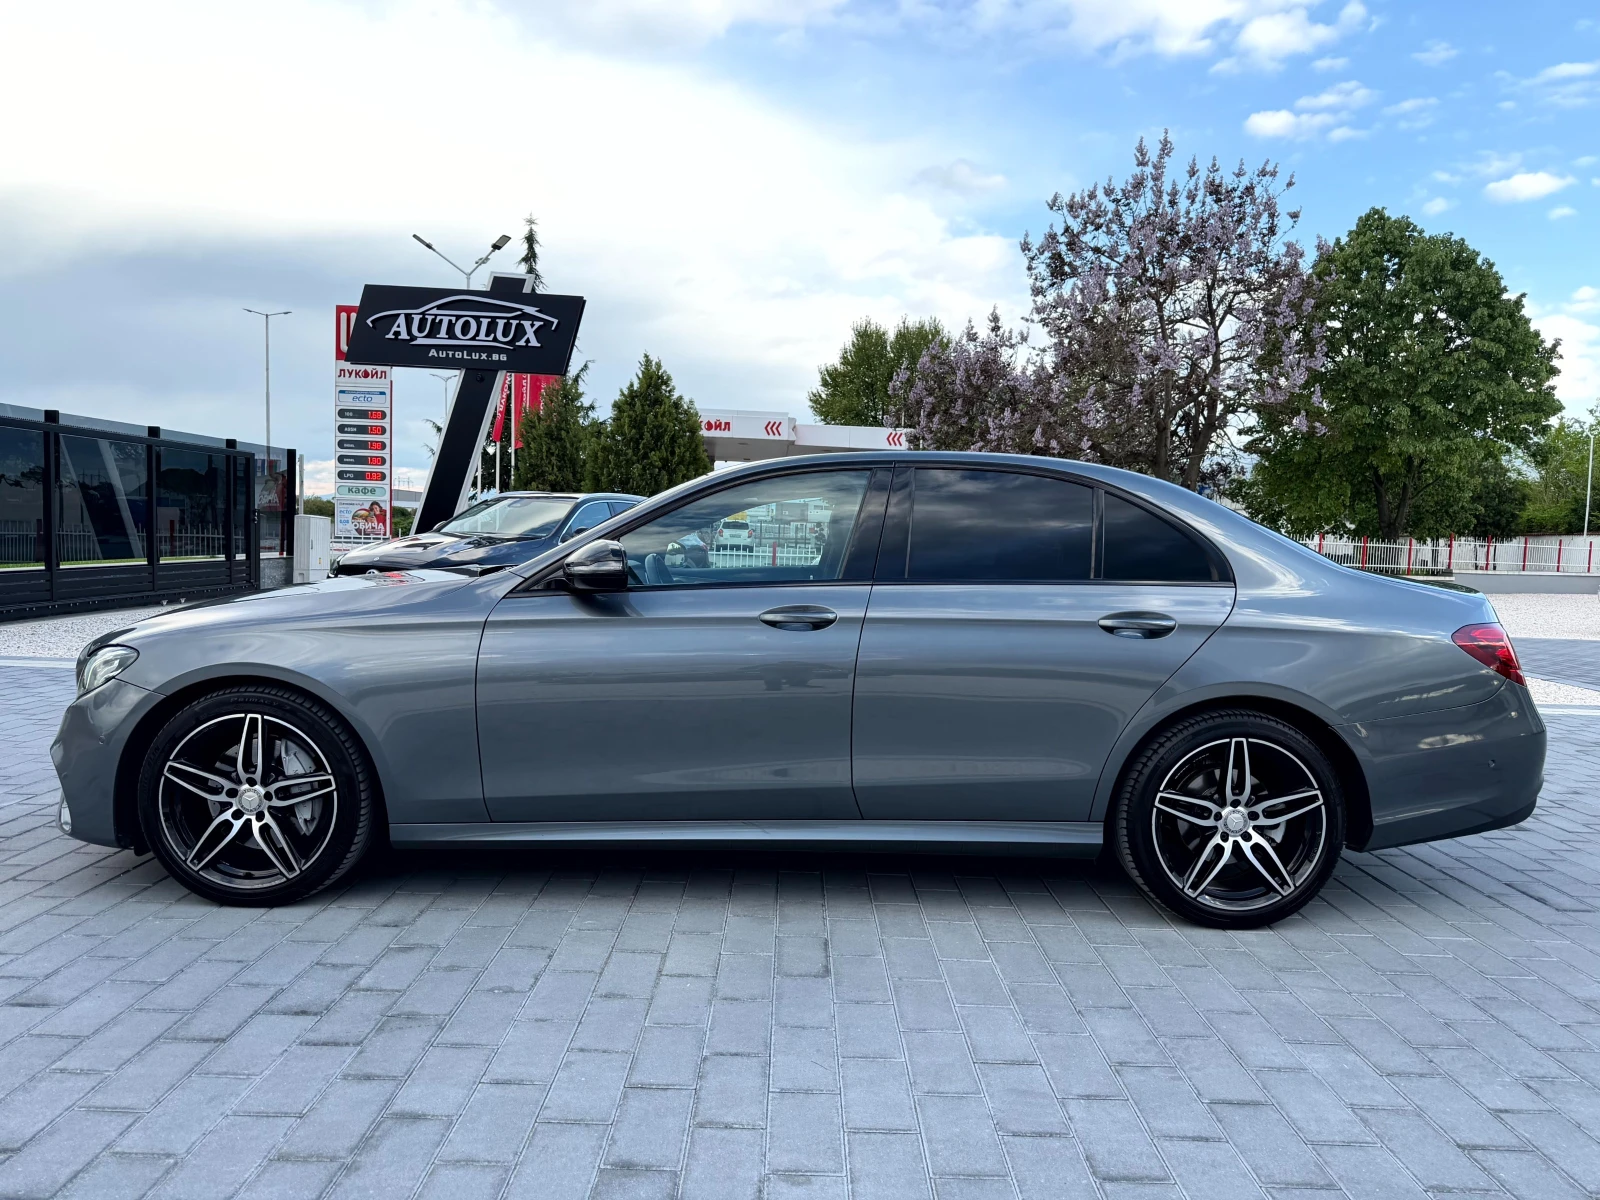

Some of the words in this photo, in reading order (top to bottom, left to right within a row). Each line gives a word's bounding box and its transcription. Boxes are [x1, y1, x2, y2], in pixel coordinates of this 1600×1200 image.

[384, 313, 544, 347] AUTOLUX
[352, 395, 373, 403] ecto
[368, 426, 382, 434] 1.50
[352, 522, 385, 530] ОБИЧА
